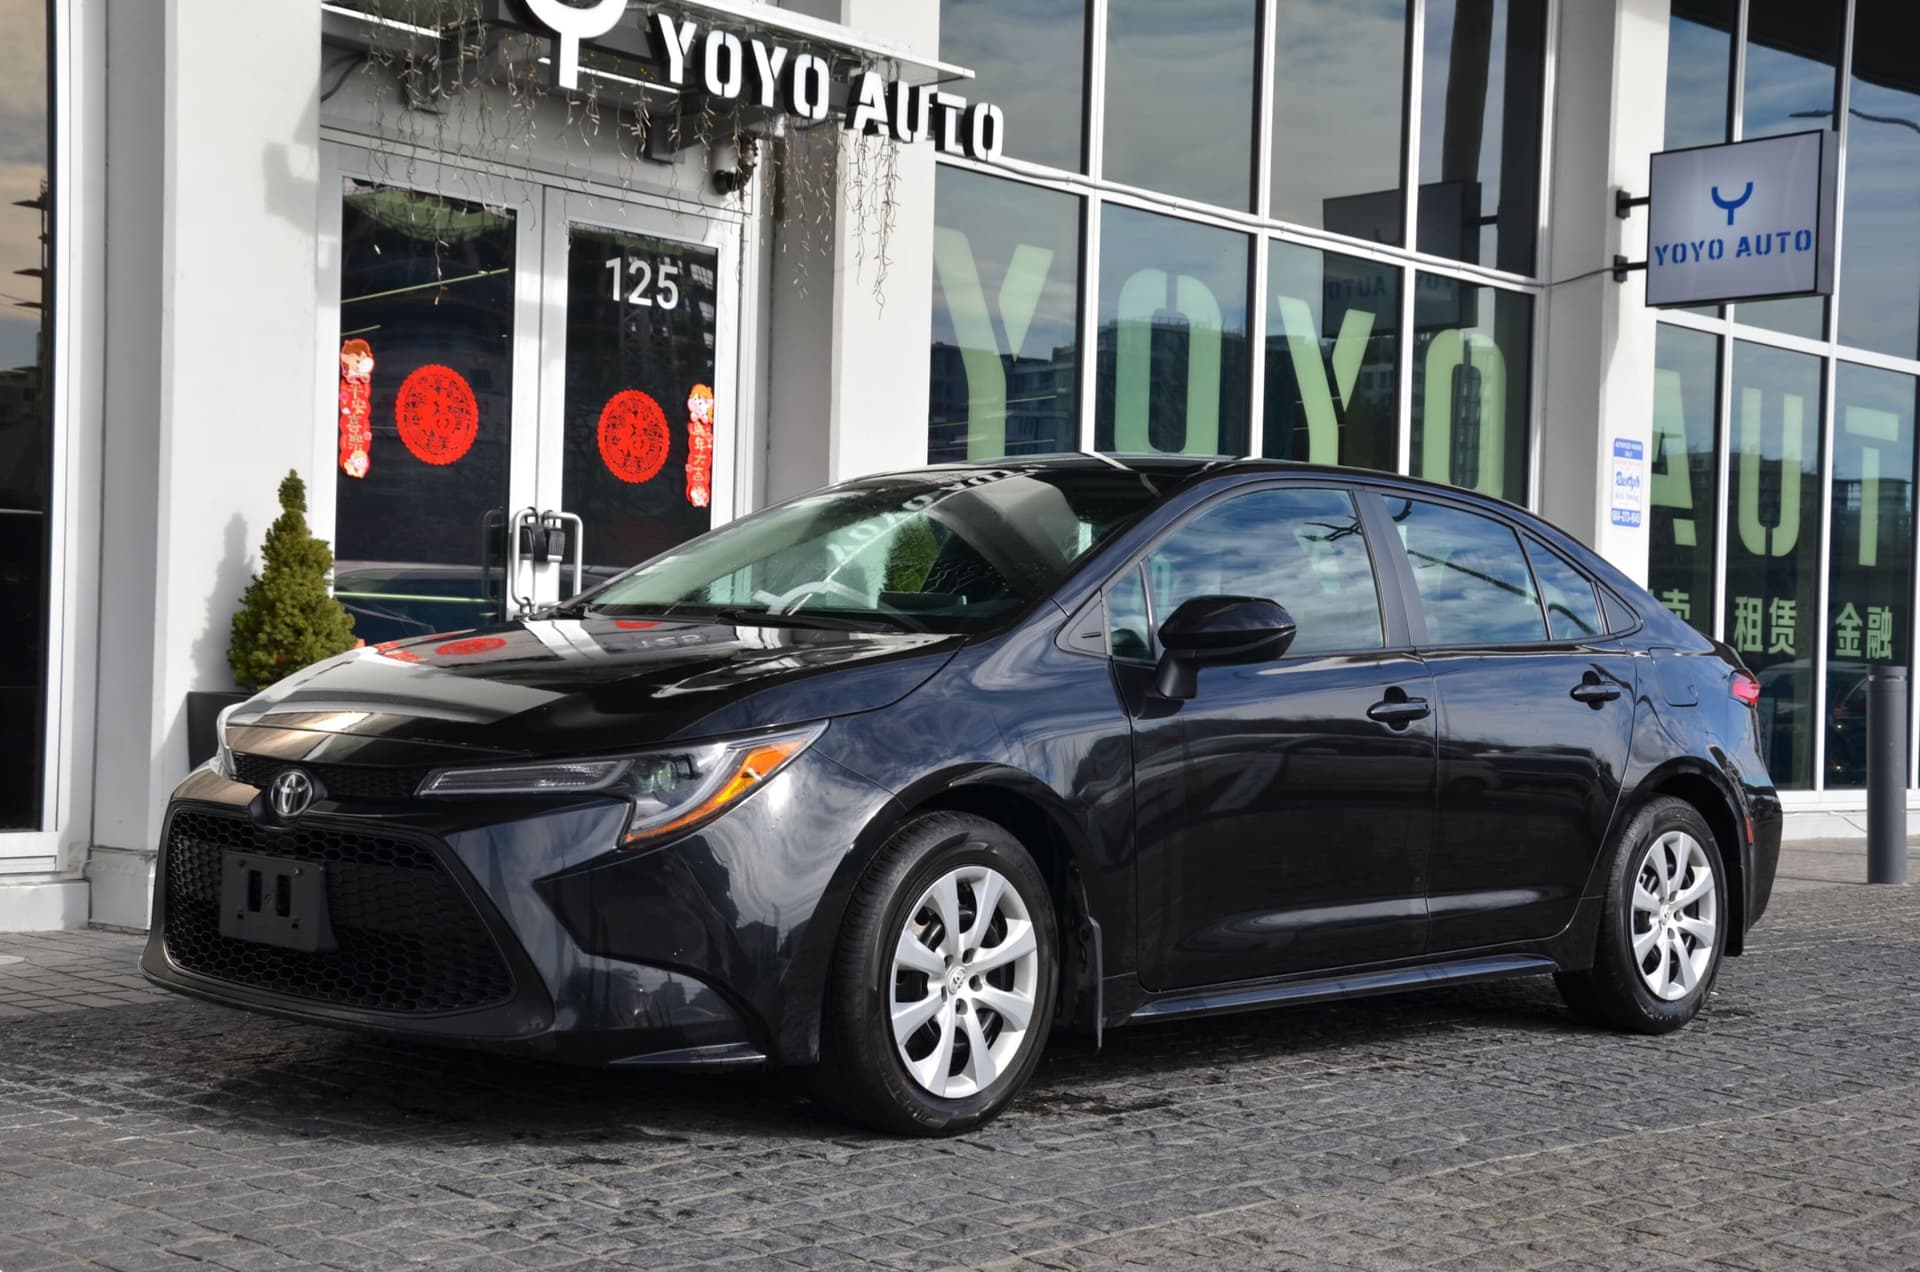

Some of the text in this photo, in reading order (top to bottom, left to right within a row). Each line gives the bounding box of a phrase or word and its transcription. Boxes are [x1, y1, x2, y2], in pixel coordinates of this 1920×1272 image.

[656, 12, 1005, 162] YOYO AUTO
[1654, 229, 1812, 266] YOYO AUTO
[605, 256, 681, 311] 125
[934, 226, 1506, 498] YOYO
[1734, 596, 1797, 656] 租赁
[1835, 602, 1893, 660] 金融
